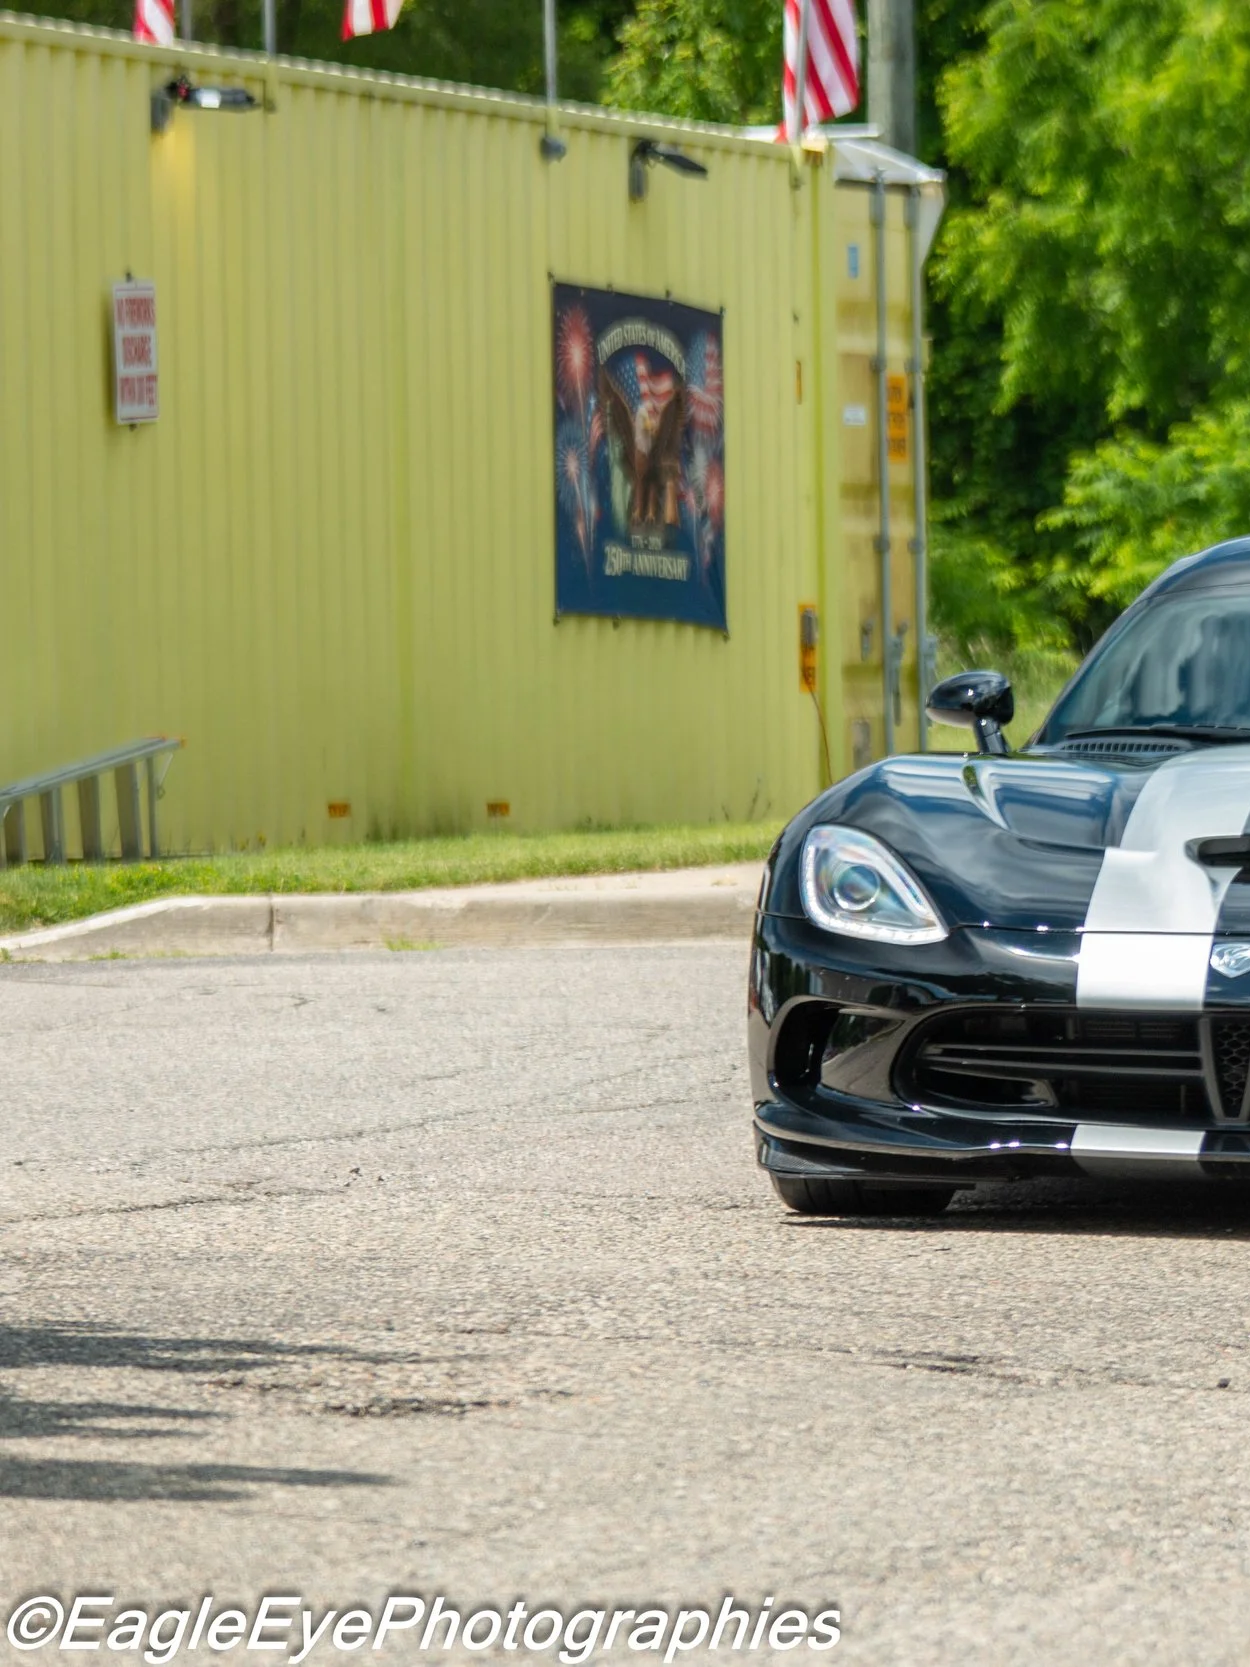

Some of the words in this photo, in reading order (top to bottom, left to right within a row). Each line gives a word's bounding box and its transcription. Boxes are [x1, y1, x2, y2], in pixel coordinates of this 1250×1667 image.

[597, 327, 622, 365] UNITED
[623, 324, 647, 347] STATES
[655, 328, 686, 381] AMERICA
[632, 553, 688, 581] ANNIVERSARY
